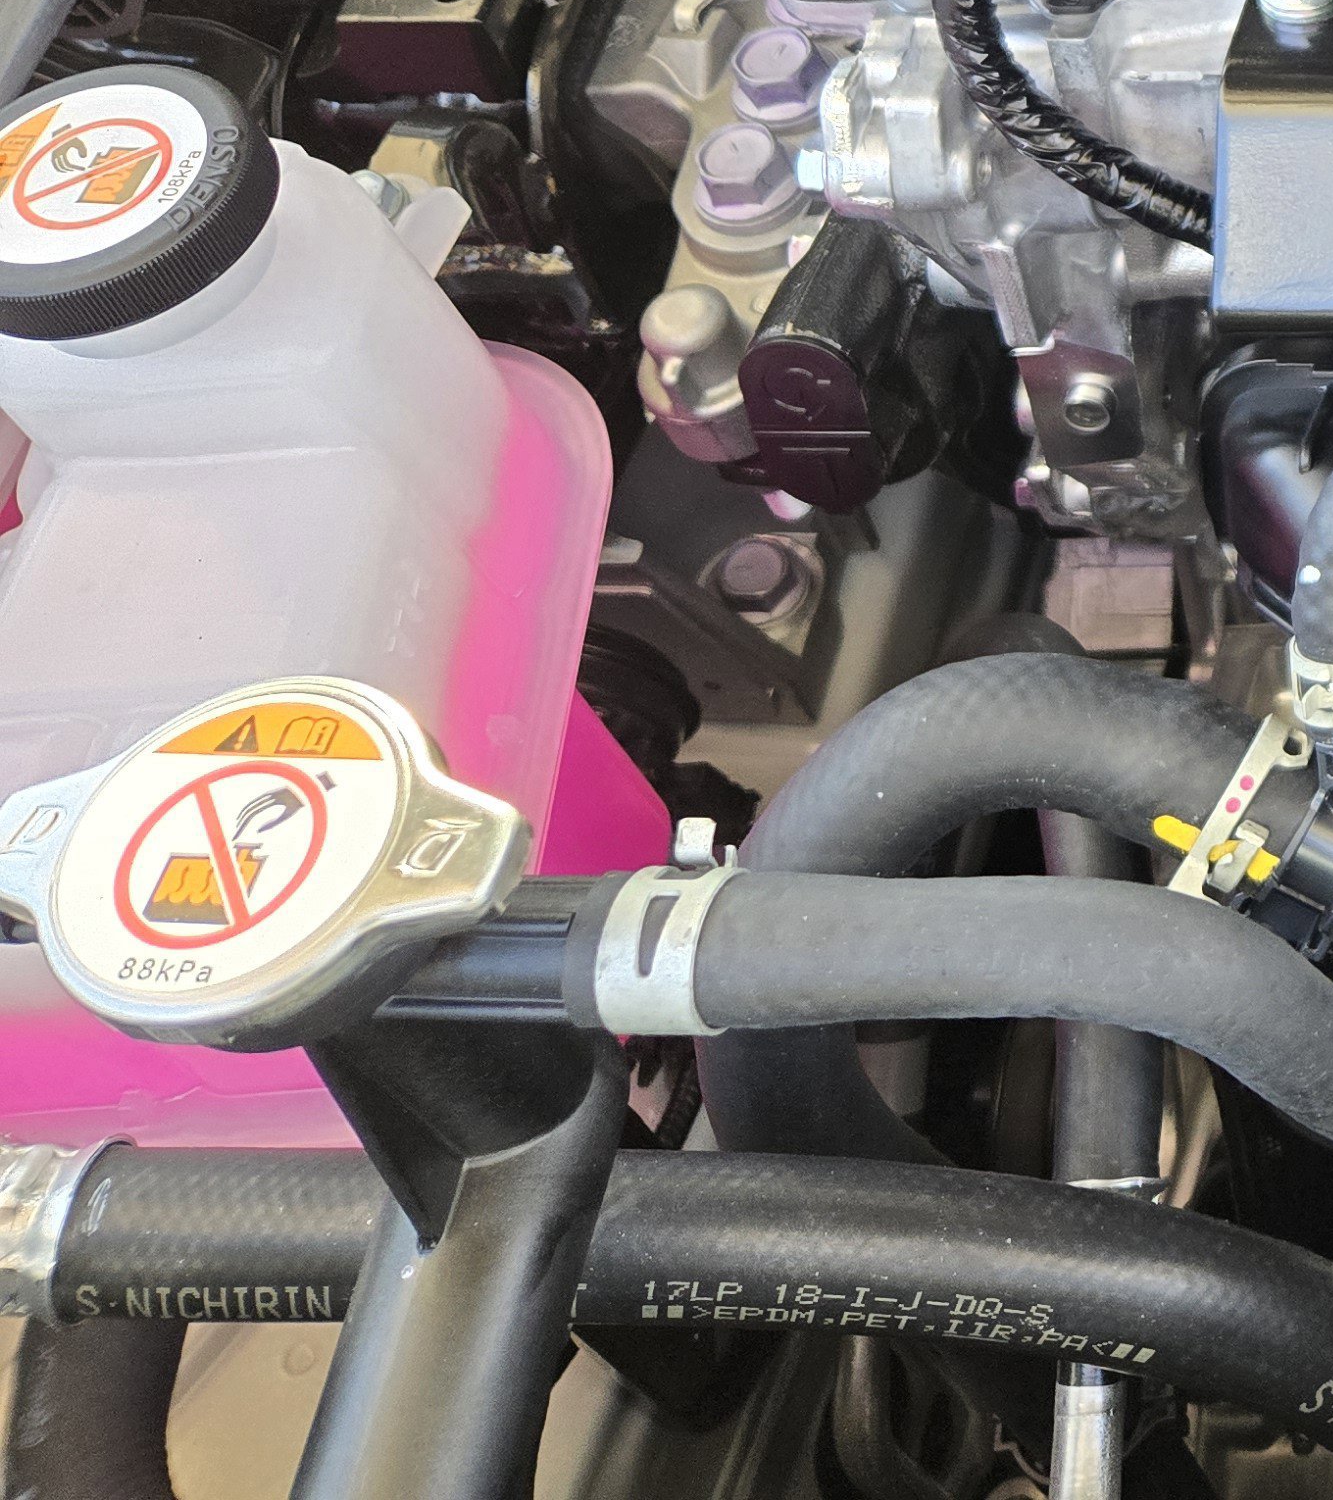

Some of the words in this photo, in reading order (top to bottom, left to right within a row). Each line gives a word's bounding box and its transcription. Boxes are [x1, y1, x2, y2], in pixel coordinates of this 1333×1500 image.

[157, 150, 202, 205] 108kPa
[164, 124, 240, 235] DENSO
[117, 956, 214, 984] 88kPa
[644, 1280, 743, 1302] 17LP
